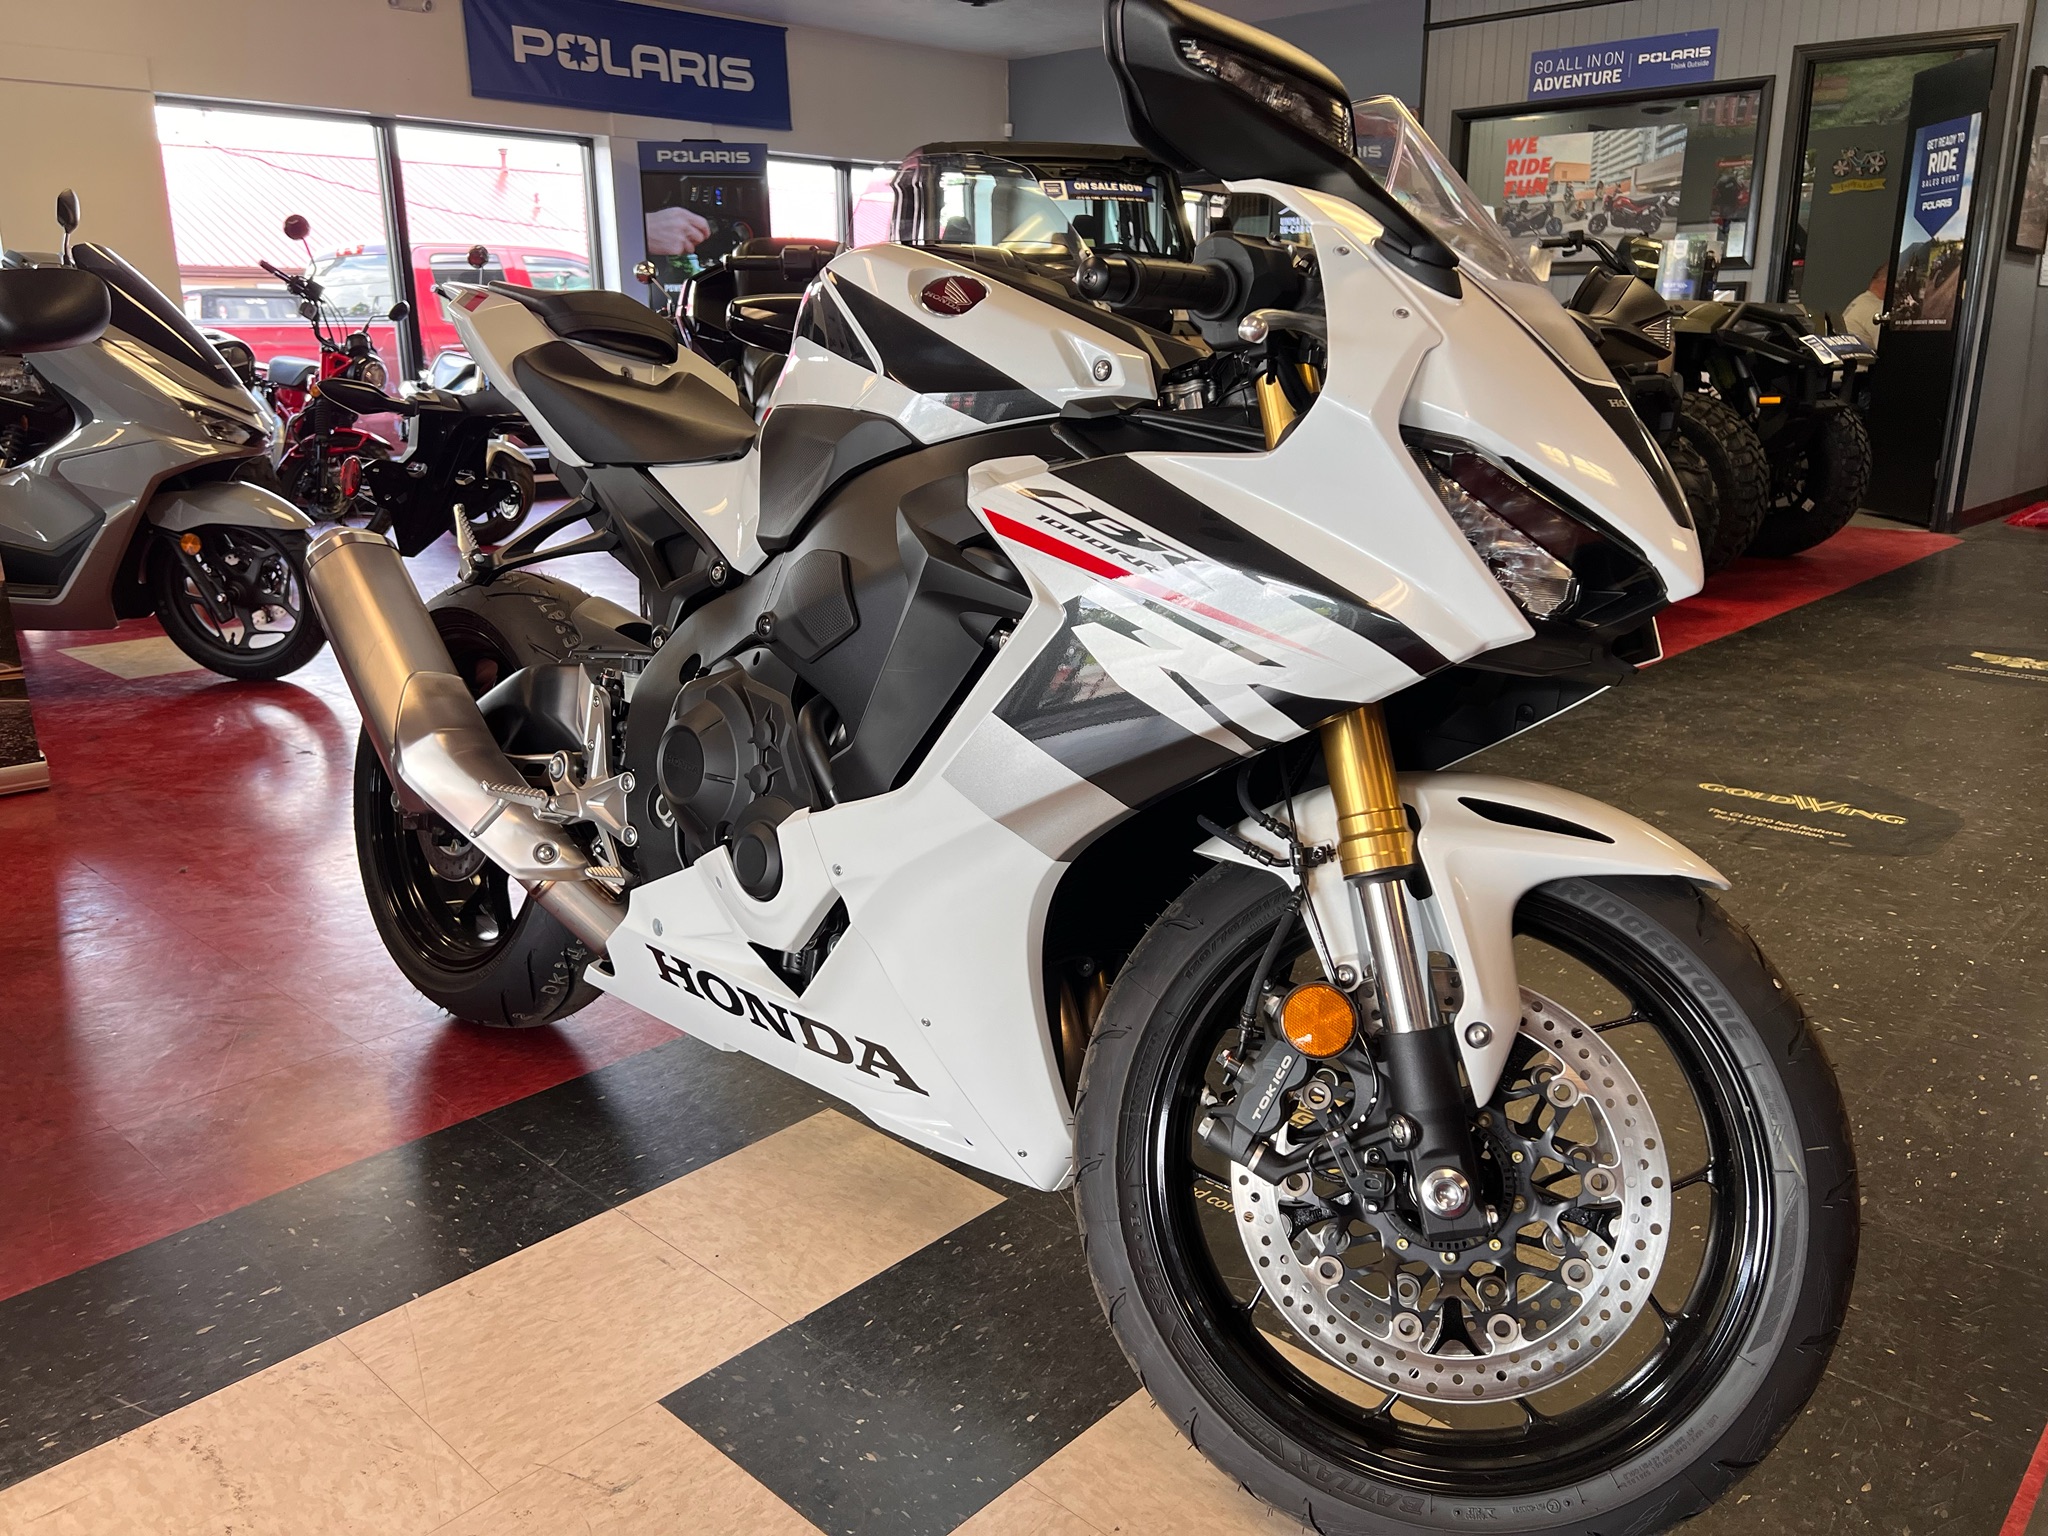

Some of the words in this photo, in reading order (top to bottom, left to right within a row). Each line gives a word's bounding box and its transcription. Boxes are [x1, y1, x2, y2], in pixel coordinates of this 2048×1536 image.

[512, 24, 755, 92] POLARIS
[1534, 60, 1553, 75] GO
[1556, 57, 1582, 71] ALL
[1587, 53, 1601, 68] IN
[1604, 51, 1624, 66] ON
[1638, 46, 1711, 65] POLARIS
[1670, 62, 1686, 70] Think
[1533, 69, 1623, 92] ADVENTURE
[1507, 136, 1539, 155] WE
[1927, 138, 1939, 150] GET
[1938, 133, 1957, 148] READY
[656, 150, 751, 164] POLARIS
[1505, 156, 1552, 177] RIDE
[1927, 147, 1959, 176] RIDE
[1074, 181, 1090, 191] ON
[1090, 182, 1119, 191] SALE
[1119, 184, 1143, 192] NOW
[1503, 177, 1548, 197] FUN
[1921, 177, 1940, 188] SALES
[1941, 173, 1960, 185] EVENT
[1922, 198, 1953, 211] POLARIS
[924, 290, 961, 312] HONDA
[1553, 882, 1750, 1041] RIDGESTONE
[645, 943, 930, 1097] HONDA
[1251, 1054, 1293, 1120] TOKICO
[1290, 1451, 1426, 1516] BATTLAX
